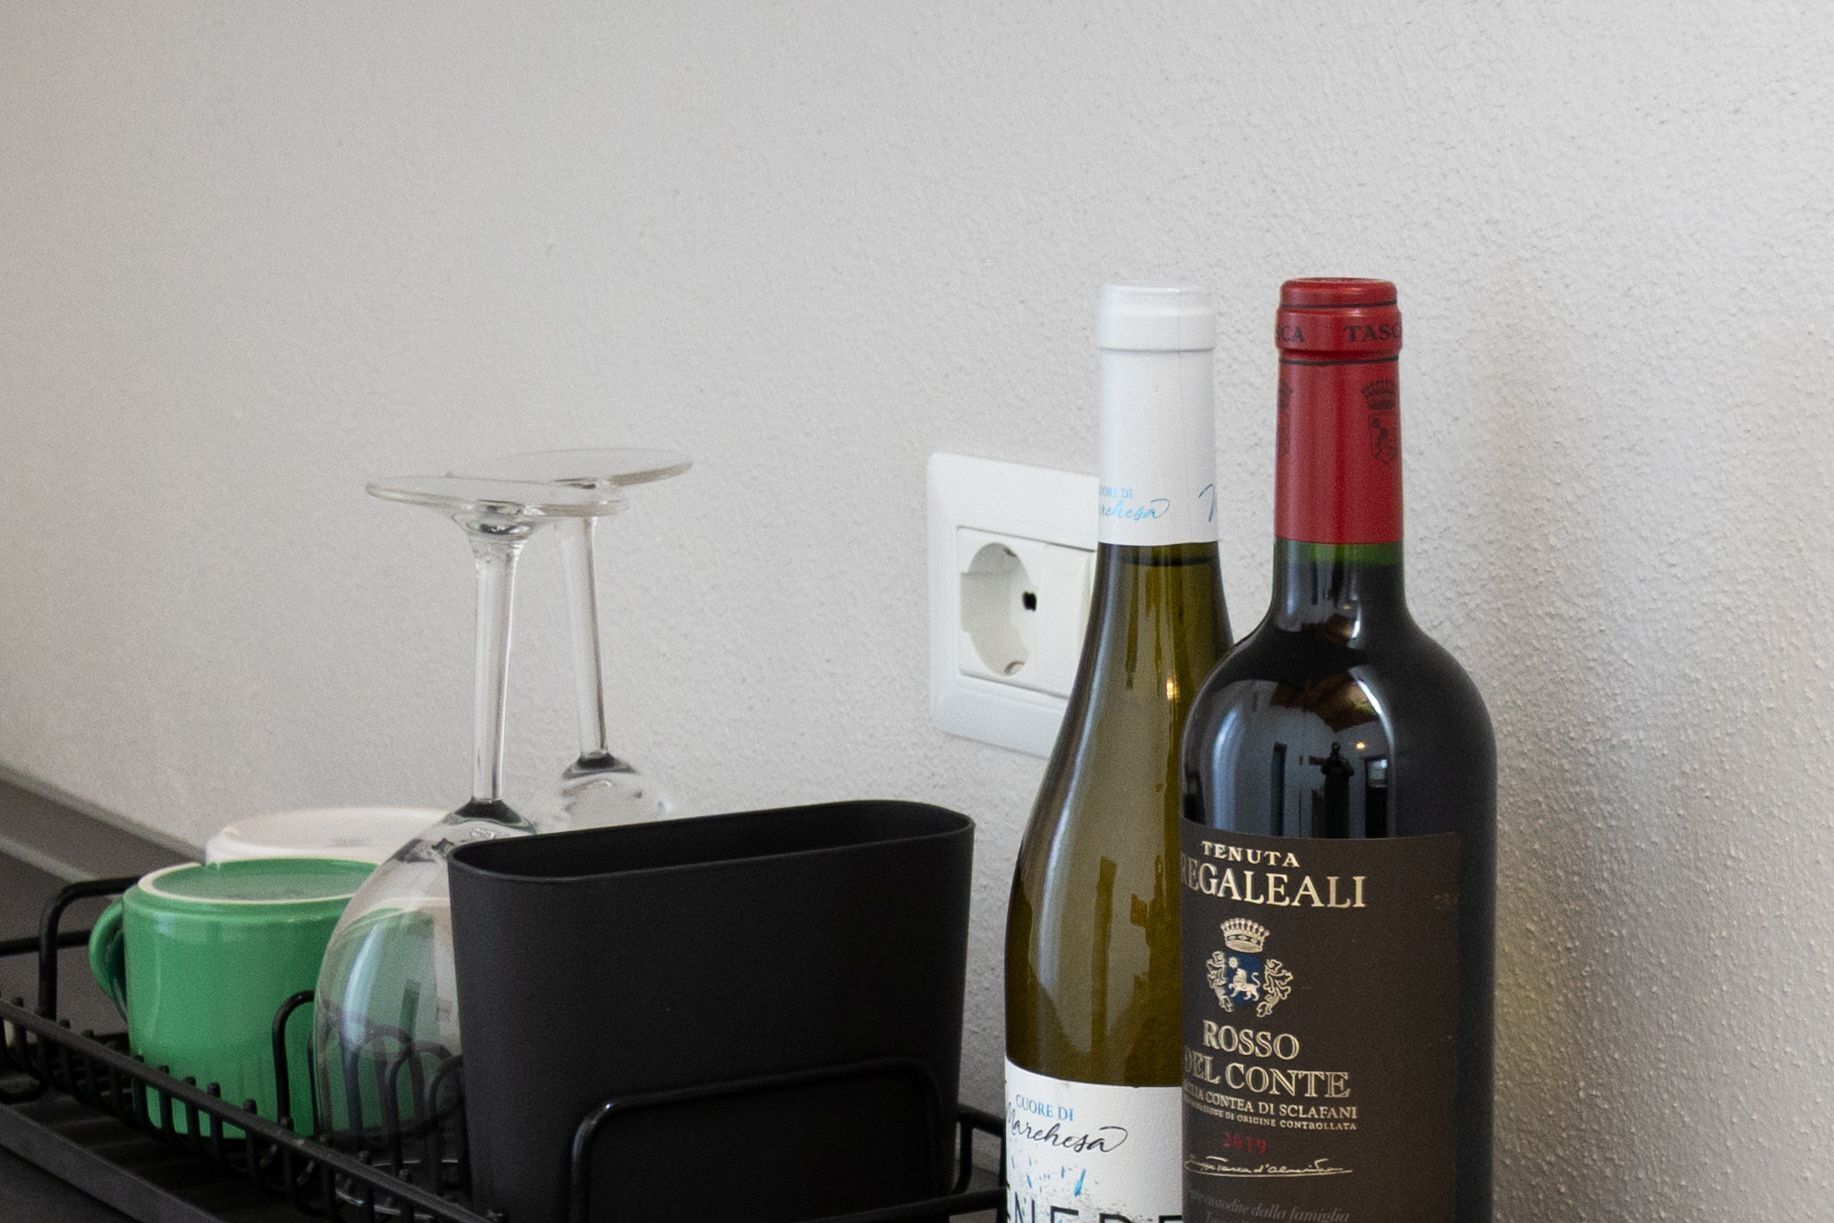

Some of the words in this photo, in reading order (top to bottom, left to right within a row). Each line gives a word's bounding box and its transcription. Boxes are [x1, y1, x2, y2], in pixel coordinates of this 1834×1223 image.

[1201, 840, 1300, 868] TENUTA
[1203, 1019, 1300, 1061] ROSSO
[1225, 1063, 1352, 1099] CONTE
[1016, 1094, 1053, 1118] CUORE
[1058, 1106, 1074, 1121] DI
[1205, 1090, 1254, 1113] CONTEA
[1258, 1101, 1275, 1116] DI
[1279, 1103, 1358, 1119] SCLAFANI
[1237, 1114, 1277, 1128] ORIGINE
[1279, 1119, 1357, 1131] CONTROLLATA
